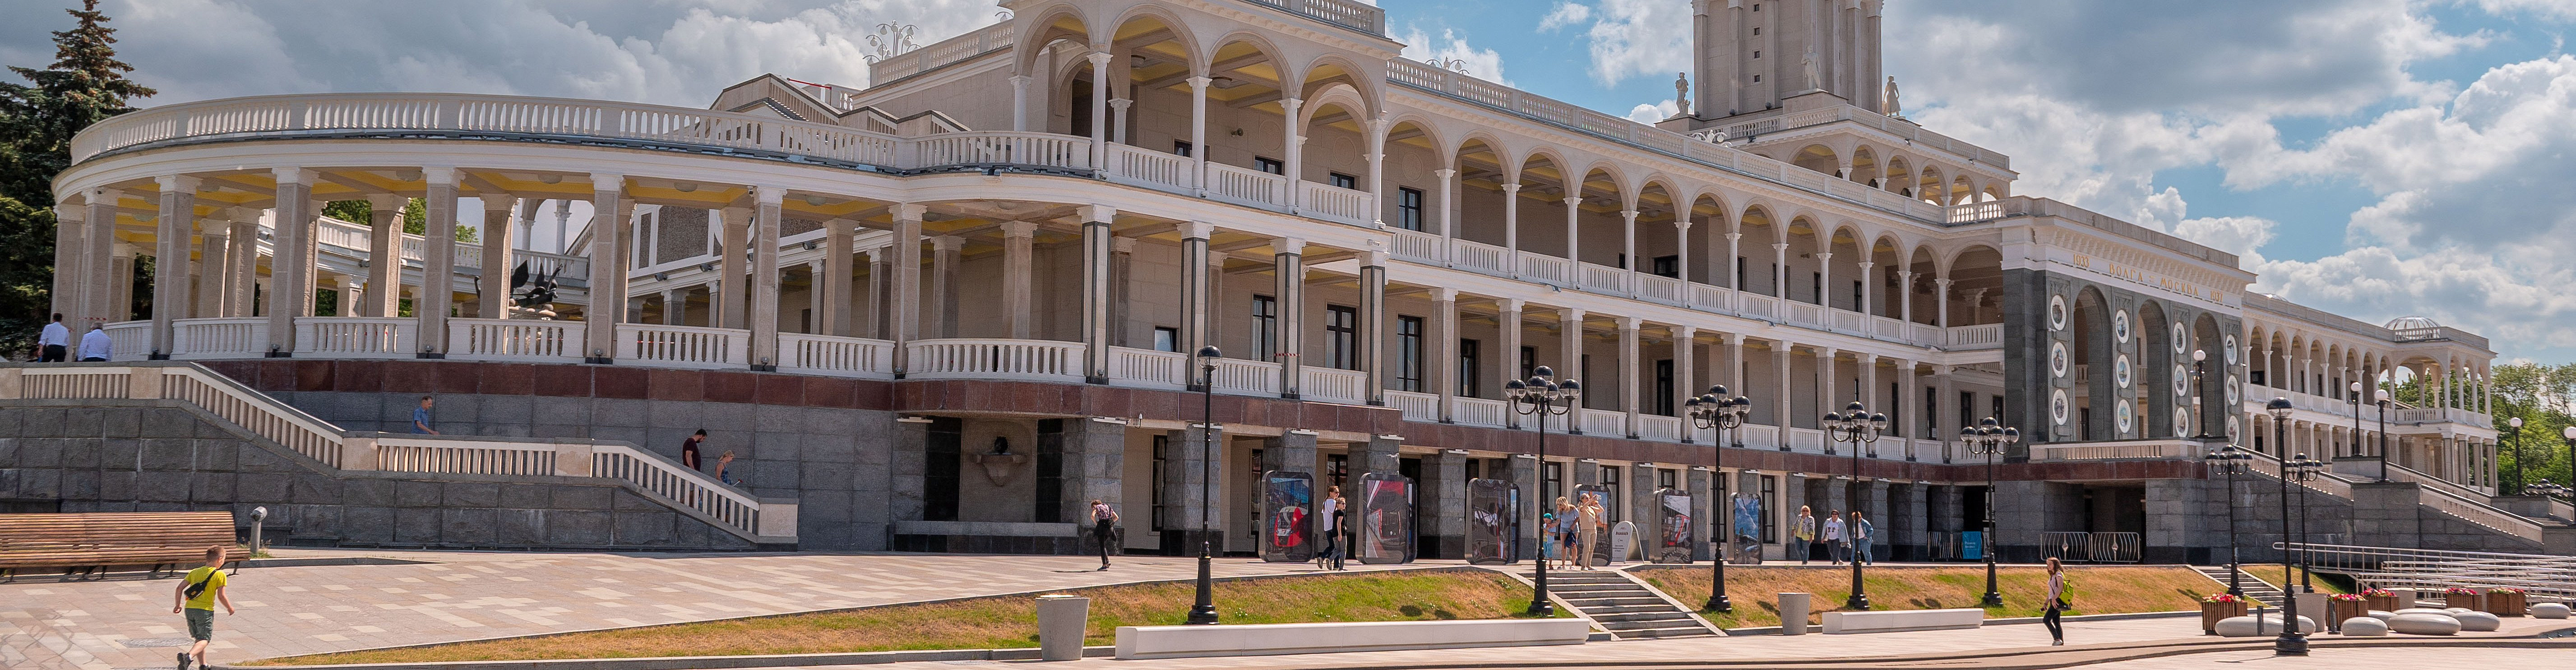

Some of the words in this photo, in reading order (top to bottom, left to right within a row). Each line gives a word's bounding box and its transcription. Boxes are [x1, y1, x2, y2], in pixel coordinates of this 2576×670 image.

[2073, 254, 2090, 268] 1933
[2109, 263, 2143, 282] ВОЛГА
[2160, 277, 2199, 296] МОСКВА
[2210, 290, 2224, 303] 1937
